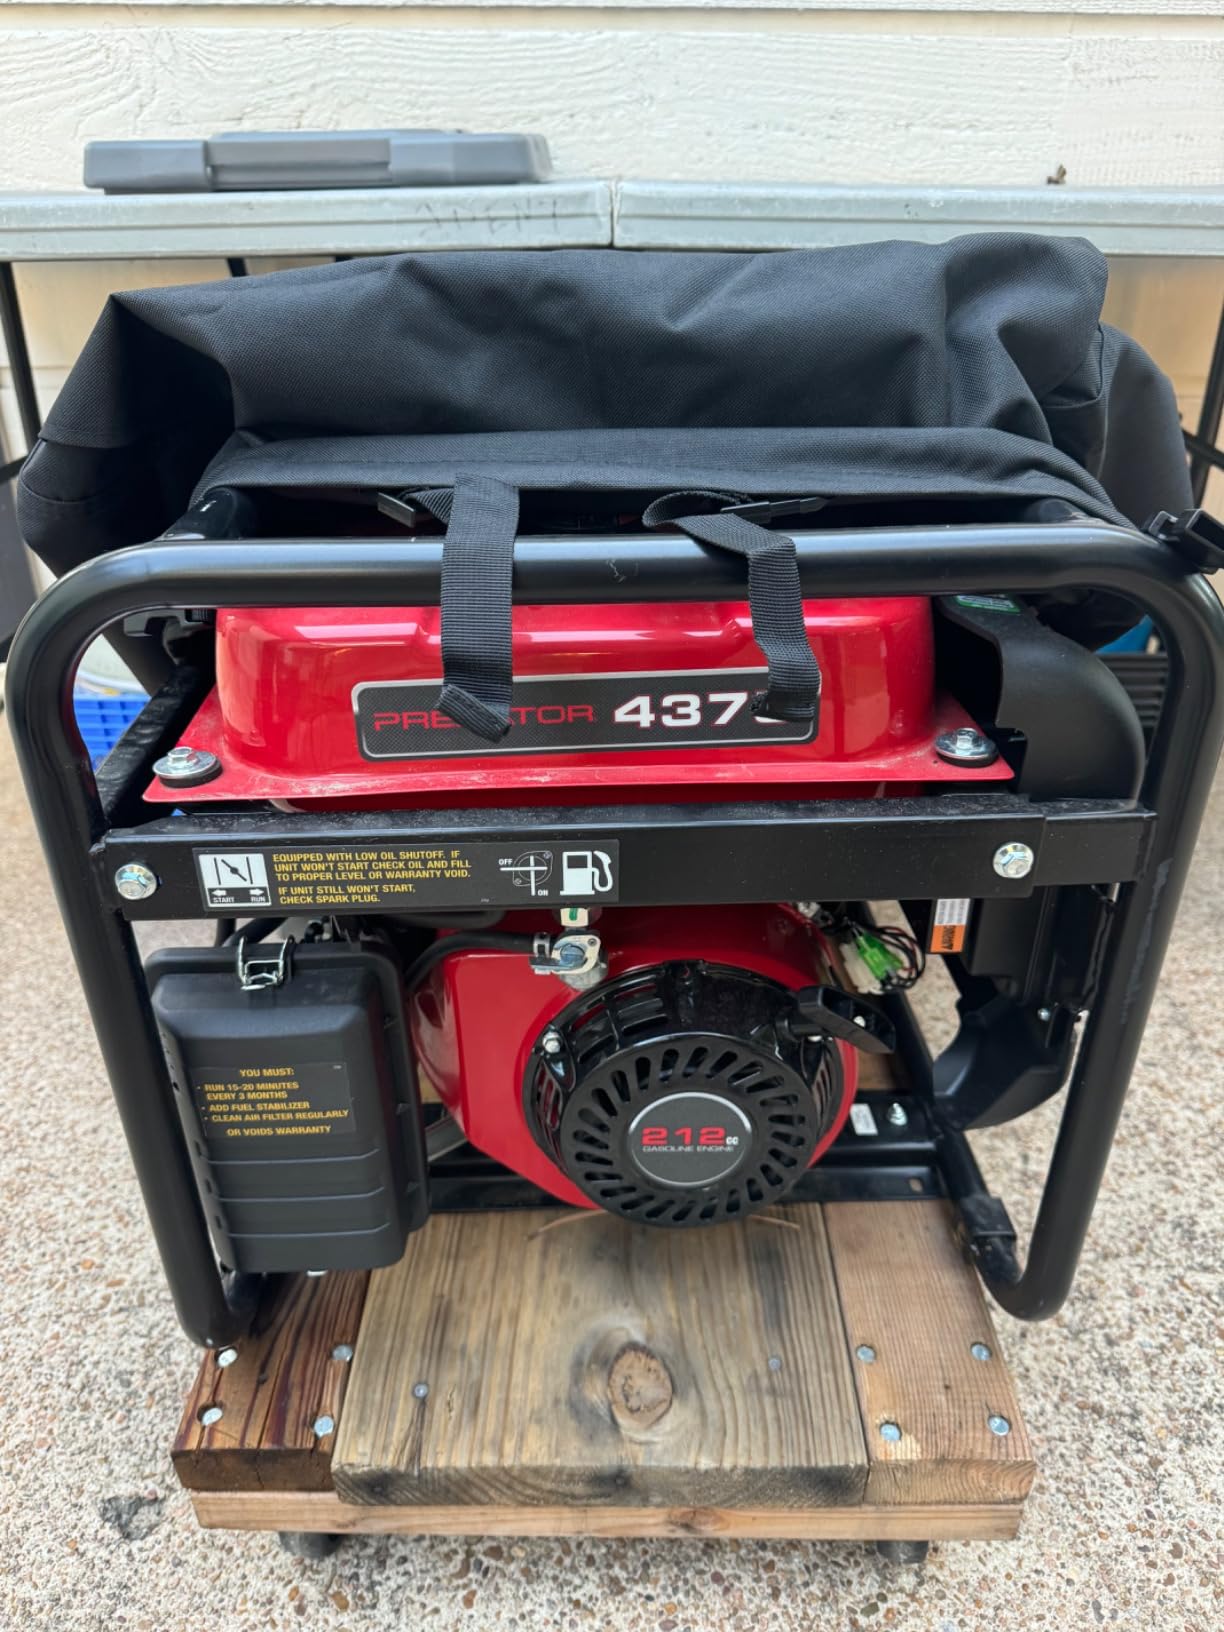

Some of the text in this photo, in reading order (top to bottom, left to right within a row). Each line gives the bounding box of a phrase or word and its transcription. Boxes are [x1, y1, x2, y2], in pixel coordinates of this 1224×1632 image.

[374, 692, 786, 730] PRETOR 437
[272, 850, 460, 862] EQUIPPED WITH LOW OIL SHUTOFF. IF
[274, 859, 472, 872] UNIT WON'T START CHECK OIL AND FILL
[276, 869, 471, 881] TO PROPER LEVEL OR WARRANTY VOID.
[278, 884, 416, 895] IF UNIT STILL WON'T START,
[279, 894, 381, 905] CHECK SPARK PLUG.
[240, 1067, 294, 1077] YOU MUST:
[227, 1083, 255, 1091] 15-20
[256, 1082, 299, 1090] MINUTES
[207, 1091, 288, 1100] EVERY 3 MONTHS
[209, 1101, 310, 1112] ADD FUEL STABILIZER
[212, 1114, 242, 1122] CLEAN
[262, 1112, 293, 1120] FILTER
[295, 1110, 349, 1119] REGULARLY
[227, 1125, 331, 1136] OR VOIDS WARRANTY
[643, 1145, 735, 1153] GASOLINE ENGINE
